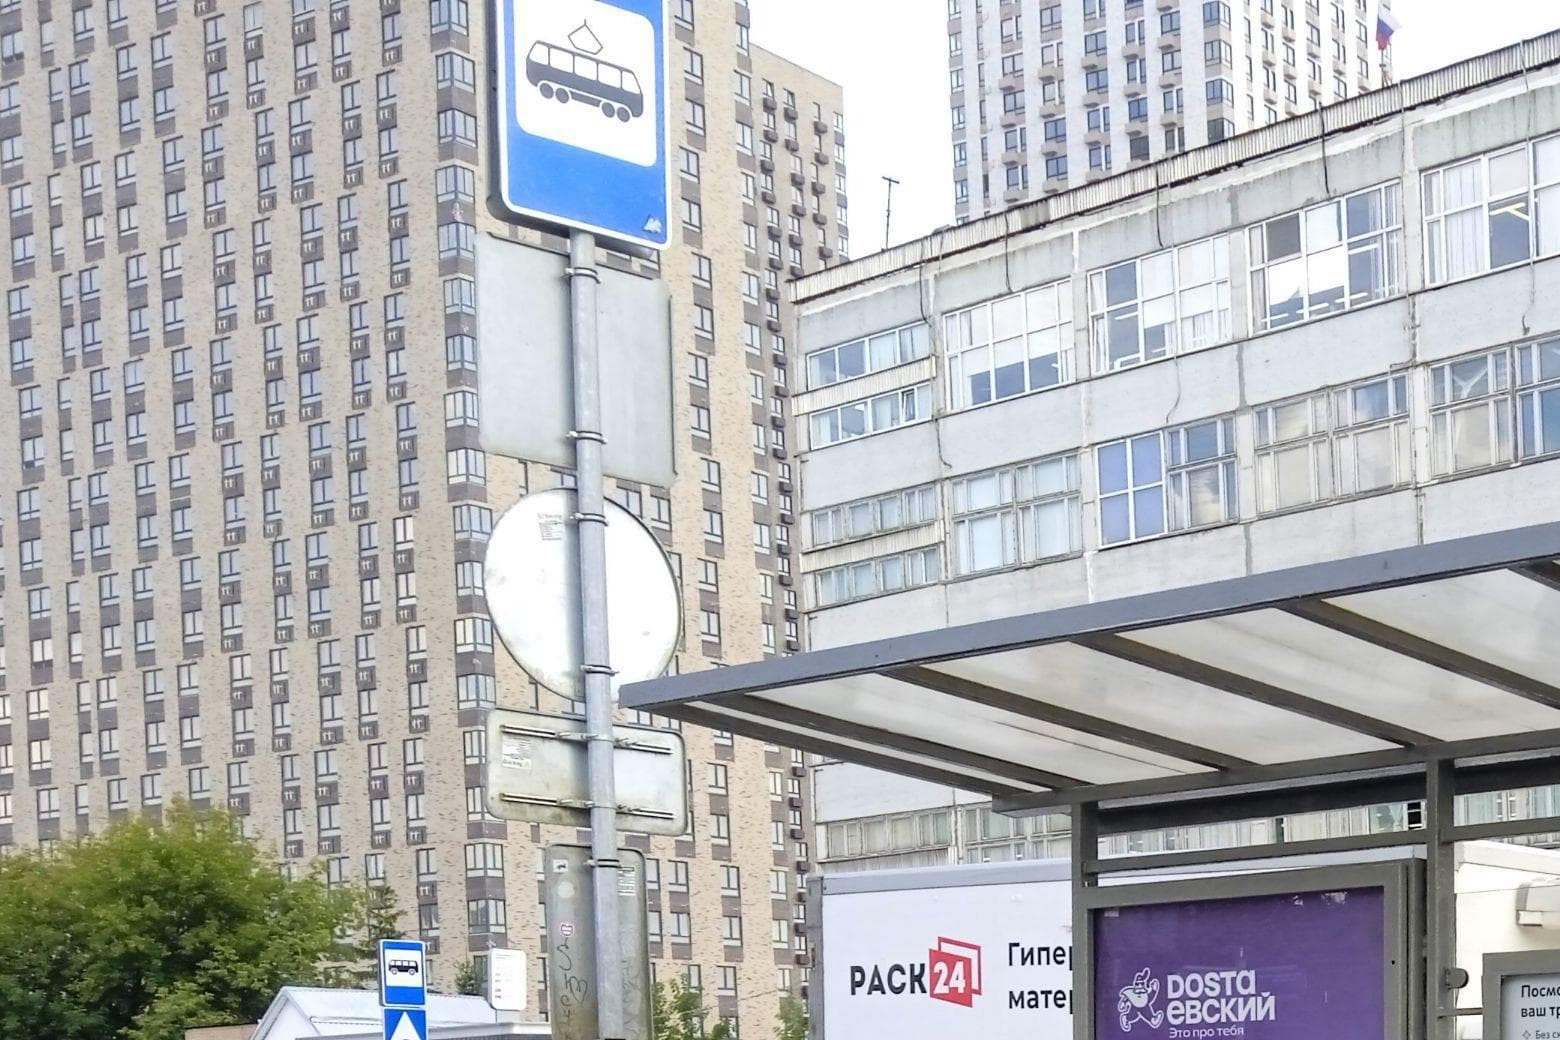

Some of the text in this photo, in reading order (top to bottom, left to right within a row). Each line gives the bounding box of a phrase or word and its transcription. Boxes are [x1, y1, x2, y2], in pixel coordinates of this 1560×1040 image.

[1520, 1006, 1546, 1018] ваш
[1169, 1026, 1245, 1040] Это про тебя
[1535, 1030, 1550, 1040] Без
